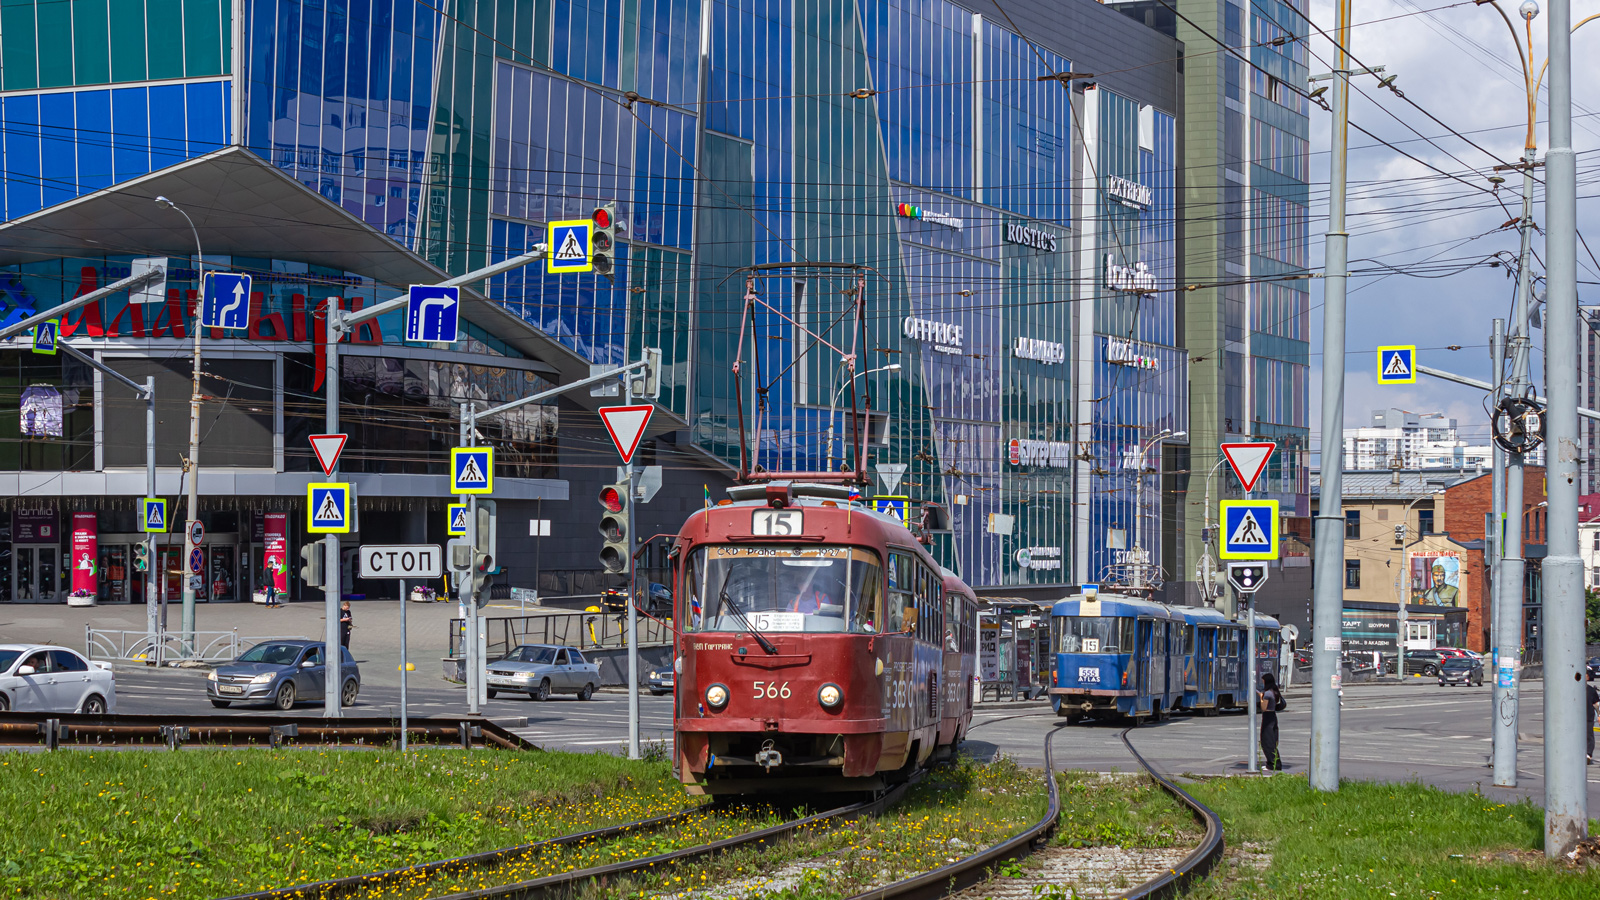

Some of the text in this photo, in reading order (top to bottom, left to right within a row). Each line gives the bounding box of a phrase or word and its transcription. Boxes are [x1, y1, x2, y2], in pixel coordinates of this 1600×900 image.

[1109, 174, 1152, 206] EXTREME
[1007, 223, 1057, 252] ROSTIC'S
[904, 316, 963, 346] OFFPRICE
[1020, 439, 1049, 468] БУРГЕР
[764, 513, 792, 535] 15
[370, 551, 431, 572] СТОП
[754, 614, 769, 631] 15
[1085, 640, 1097, 651] 15
[1082, 669, 1096, 677] 555
[753, 681, 792, 699] 566
